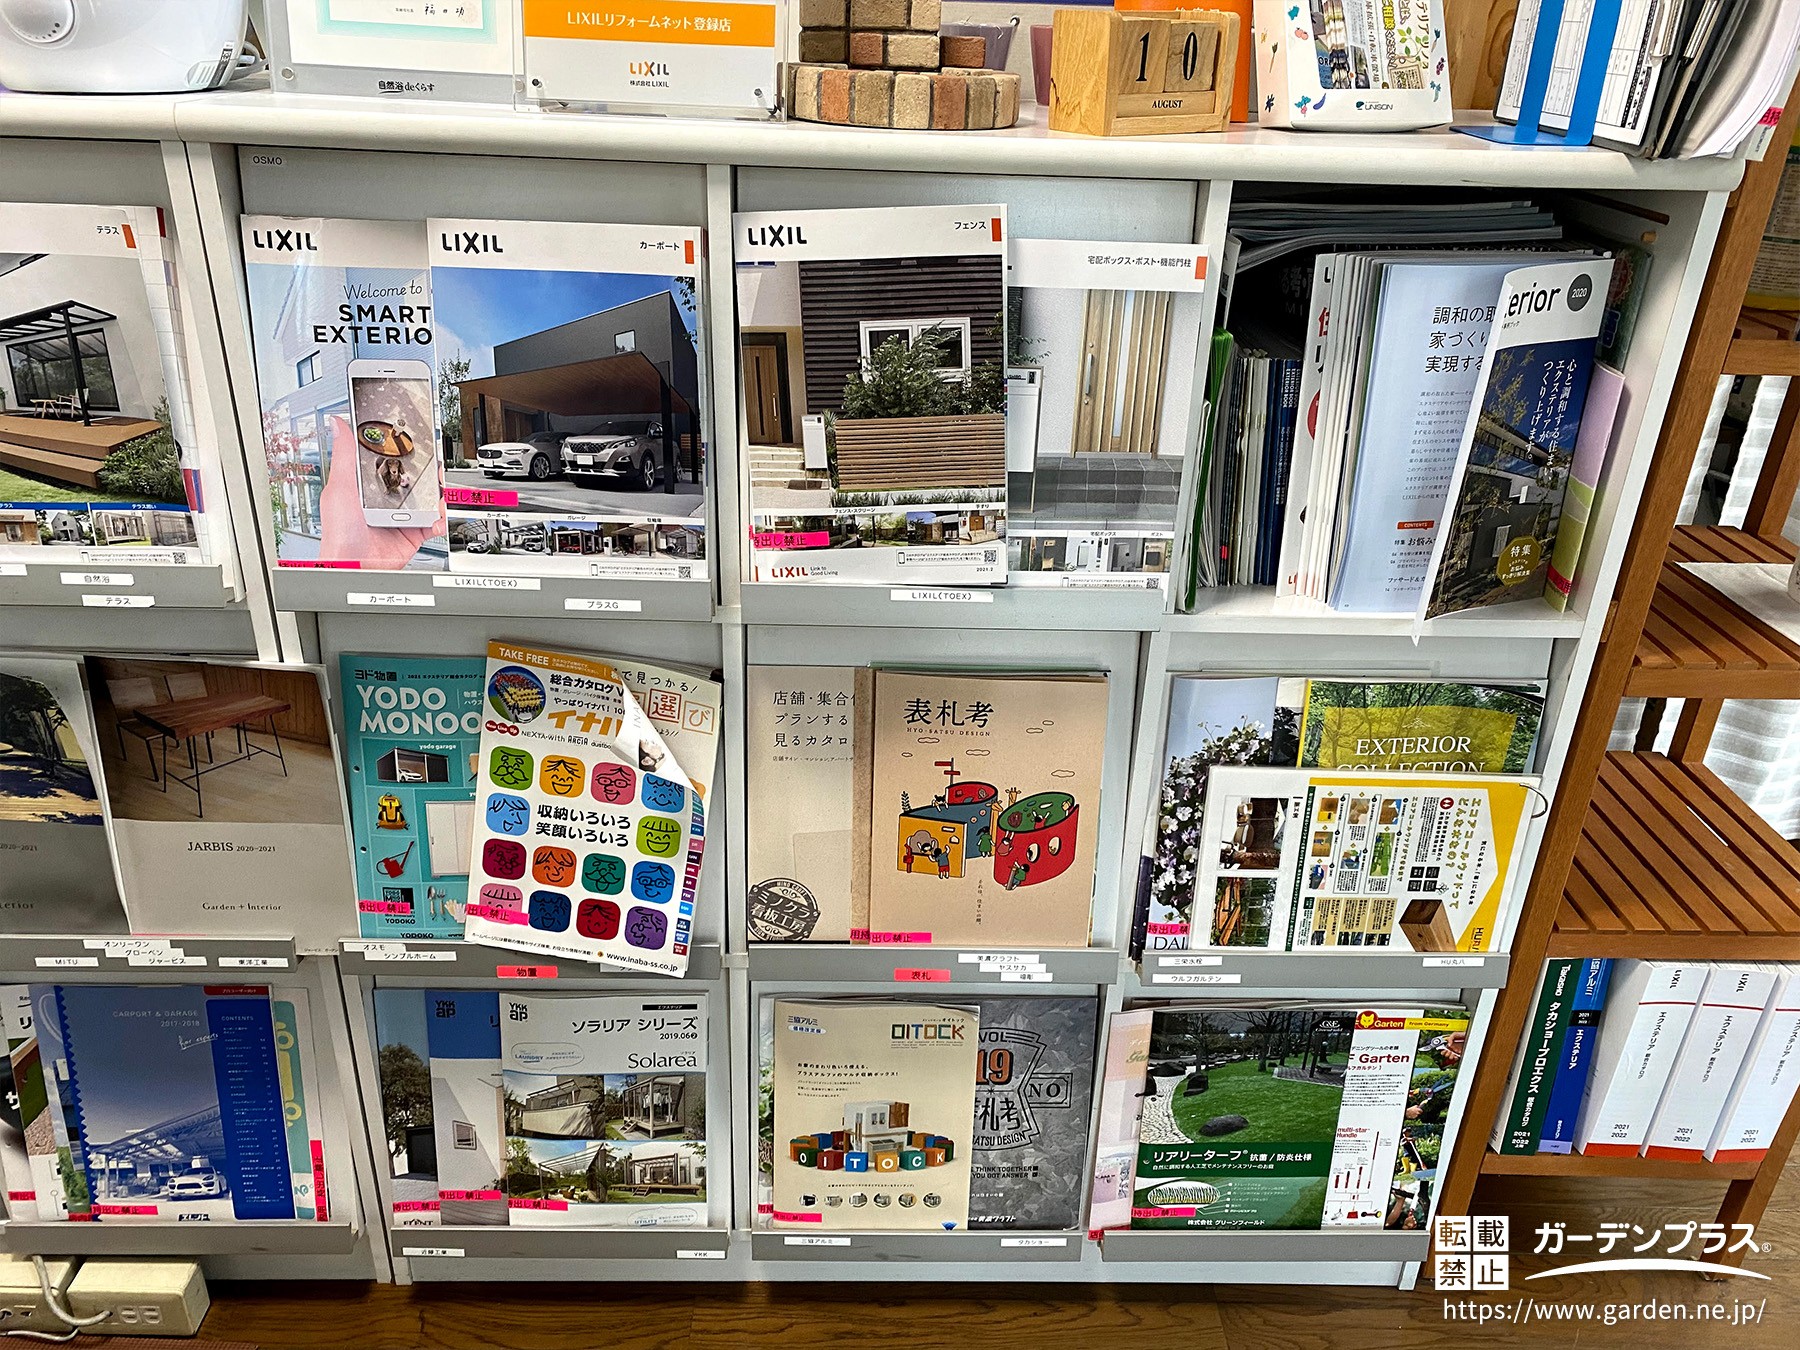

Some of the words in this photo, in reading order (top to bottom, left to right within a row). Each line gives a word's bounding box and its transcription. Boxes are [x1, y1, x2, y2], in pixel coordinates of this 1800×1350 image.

[566, 10, 732, 33] LIXILリフォームネット登録店
[629, 60, 670, 77] LIXIL
[1151, 98, 1183, 109] AUGUST
[1364, 103, 1394, 111] UNISON
[253, 156, 282, 165] OSMO
[96, 224, 120, 236] テラス
[953, 219, 988, 231] フェンス
[253, 229, 318, 253] LIXIL
[747, 224, 808, 247] LIXIL
[442, 231, 504, 255] LIXIL
[639, 239, 680, 251] カーポート
[343, 282, 407, 300] Welcome
[408, 279, 423, 296] to
[1571, 287, 1588, 299] 2020
[1504, 282, 1562, 319] erior
[338, 303, 433, 324] SMART
[1538, 360, 1565, 443] エクステリアが
[1524, 360, 1554, 460] つくり上げます。
[1510, 544, 1531, 558] 特集
[771, 566, 808, 578] LIXIL
[454, 577, 519, 590] LIXIL(TOEX)
[105, 596, 131, 606] テラス
[369, 594, 412, 605] カーポート
[911, 591, 972, 601] LIXIL(TOEX)
[499, 647, 524, 662] TAKE
[525, 653, 549, 667] FREE
[354, 669, 398, 682] ヨド物置
[549, 673, 614, 694] 総合カタログ
[356, 684, 447, 711] YODO
[774, 712, 849, 726] プランする
[902, 697, 995, 729] 表札考
[906, 727, 955, 736] HYO-SATSU
[959, 729, 991, 737] DESIGN
[1354, 735, 1472, 756] EXTERIOR
[537, 803, 632, 830] 収納いろいろ
[535, 821, 629, 848] 笑顔いろいろ
[187, 841, 234, 852] JARBIS
[235, 845, 277, 853] 2020-2021
[202, 901, 236, 911] Garden
[247, 901, 282, 911] Interior
[757, 890, 811, 919] ミノクラ
[750, 902, 807, 934] 看板工房
[103, 940, 150, 949] オンリーワン
[148, 957, 187, 965] ジャービス
[384, 952, 437, 960] シンプルホーム
[607, 951, 679, 973] www.inaba-ss.co.jp
[515, 967, 538, 977] 物置
[999, 964, 1027, 972] ヤスサカ
[911, 970, 932, 981] 表札
[1171, 975, 1222, 983] ウルフガルテン
[1669, 970, 1682, 989] LIXIL
[1736, 973, 1750, 992] LIXIL
[434, 1000, 455, 1008] YKK
[509, 1002, 528, 1011] YKK
[113, 1010, 151, 1018] CARPORT
[164, 1009, 199, 1017] GARAGE
[435, 1008, 456, 1018] ap
[509, 1010, 529, 1021] ap
[160, 1020, 200, 1028] 2017-2018
[572, 1018, 631, 1034] ソラリア
[637, 1016, 699, 1031] シリーズ
[787, 1015, 819, 1026] 三協アルミ
[1374, 1020, 1404, 1028] Garten
[891, 1024, 965, 1040] OITOCK
[1647, 1011, 1668, 1051] エクステリア
[1711, 1015, 1733, 1055] エクステリア
[1527, 1001, 1562, 1094] タカショープロエクス
[1568, 1029, 1585, 1070] エクステリア
[627, 1053, 698, 1070] Solarea
[1358, 1053, 1410, 1064] Garten
[1028, 1083, 1061, 1098] NO
[1613, 1123, 1631, 1131] 2021
[997, 1131, 1027, 1146] DESIGN
[1214, 1219, 1266, 1227] グリーンフィールド
